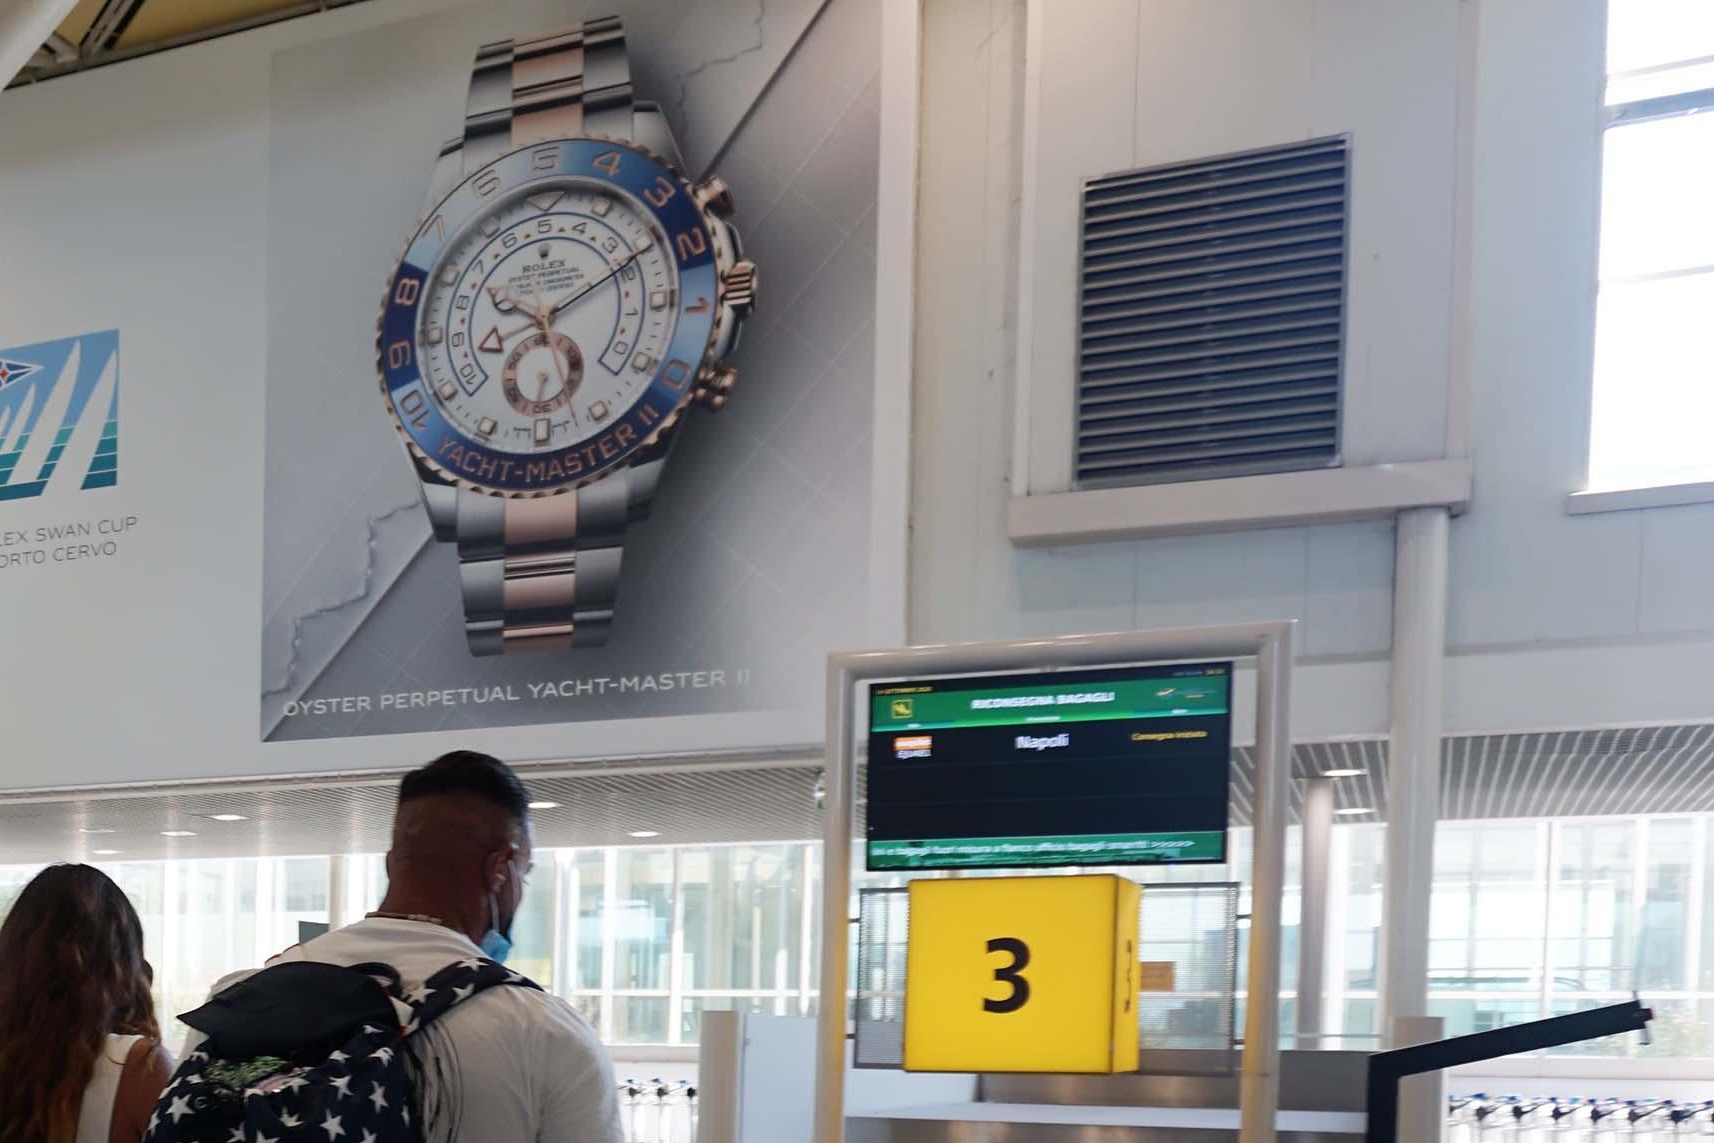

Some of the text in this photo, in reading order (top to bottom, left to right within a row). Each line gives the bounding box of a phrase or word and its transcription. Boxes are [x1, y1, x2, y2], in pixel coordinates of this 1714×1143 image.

[522, 259, 567, 273] ROLEX
[438, 423, 638, 482] YACHT-MASTER
[36, 521, 91, 543] SWAN
[97, 515, 139, 535] CUP
[53, 541, 117, 562] CERVO
[283, 669, 751, 717] OYSTER PERPETUAL YACHT-MASTER II
[970, 692, 1116, 710] RICONSEGNA BAGAGLI
[1015, 733, 1070, 750] Napoli
[981, 936, 1031, 1014] 3
